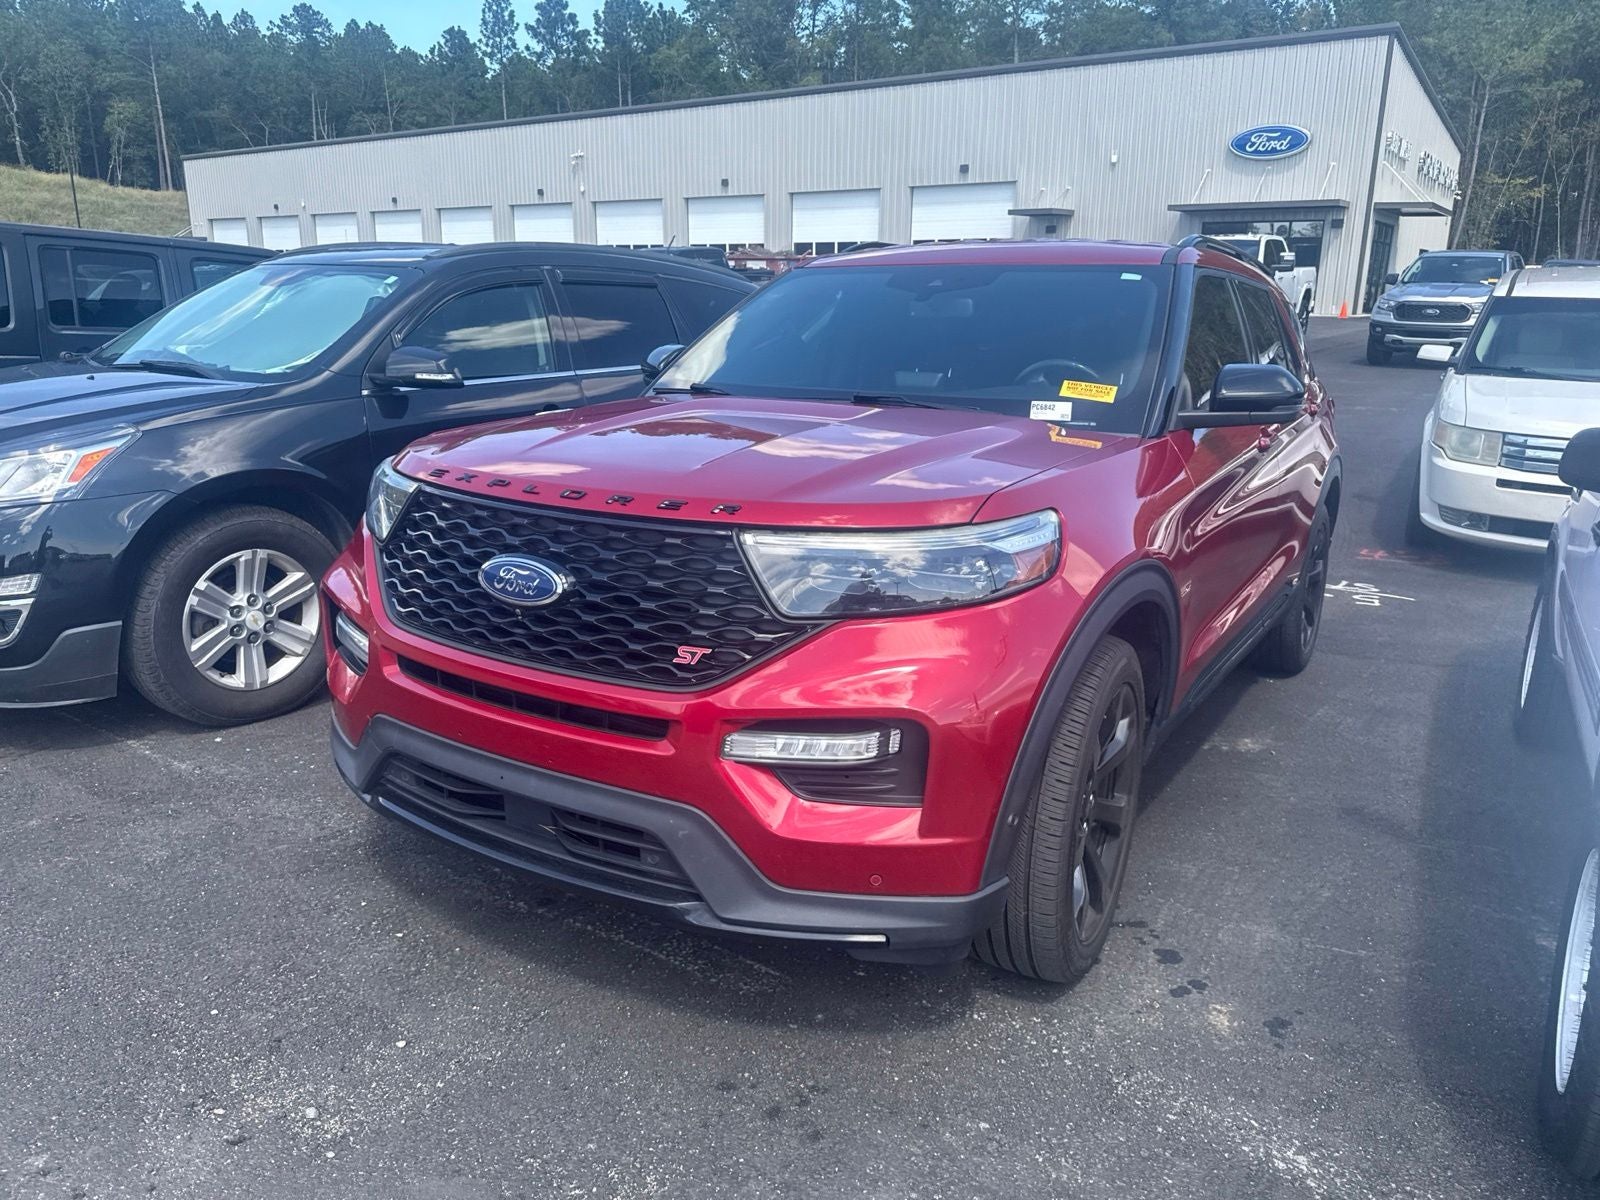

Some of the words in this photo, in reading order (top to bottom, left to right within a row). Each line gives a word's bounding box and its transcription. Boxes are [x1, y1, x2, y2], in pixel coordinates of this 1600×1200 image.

[1245, 132, 1292, 152] Ford
[1084, 383, 1114, 391] VEHICLE
[1031, 403, 1056, 411] PC6842
[428, 468, 742, 515] EXPLORER
[494, 566, 540, 596] Ford
[672, 645, 713, 665] ST
